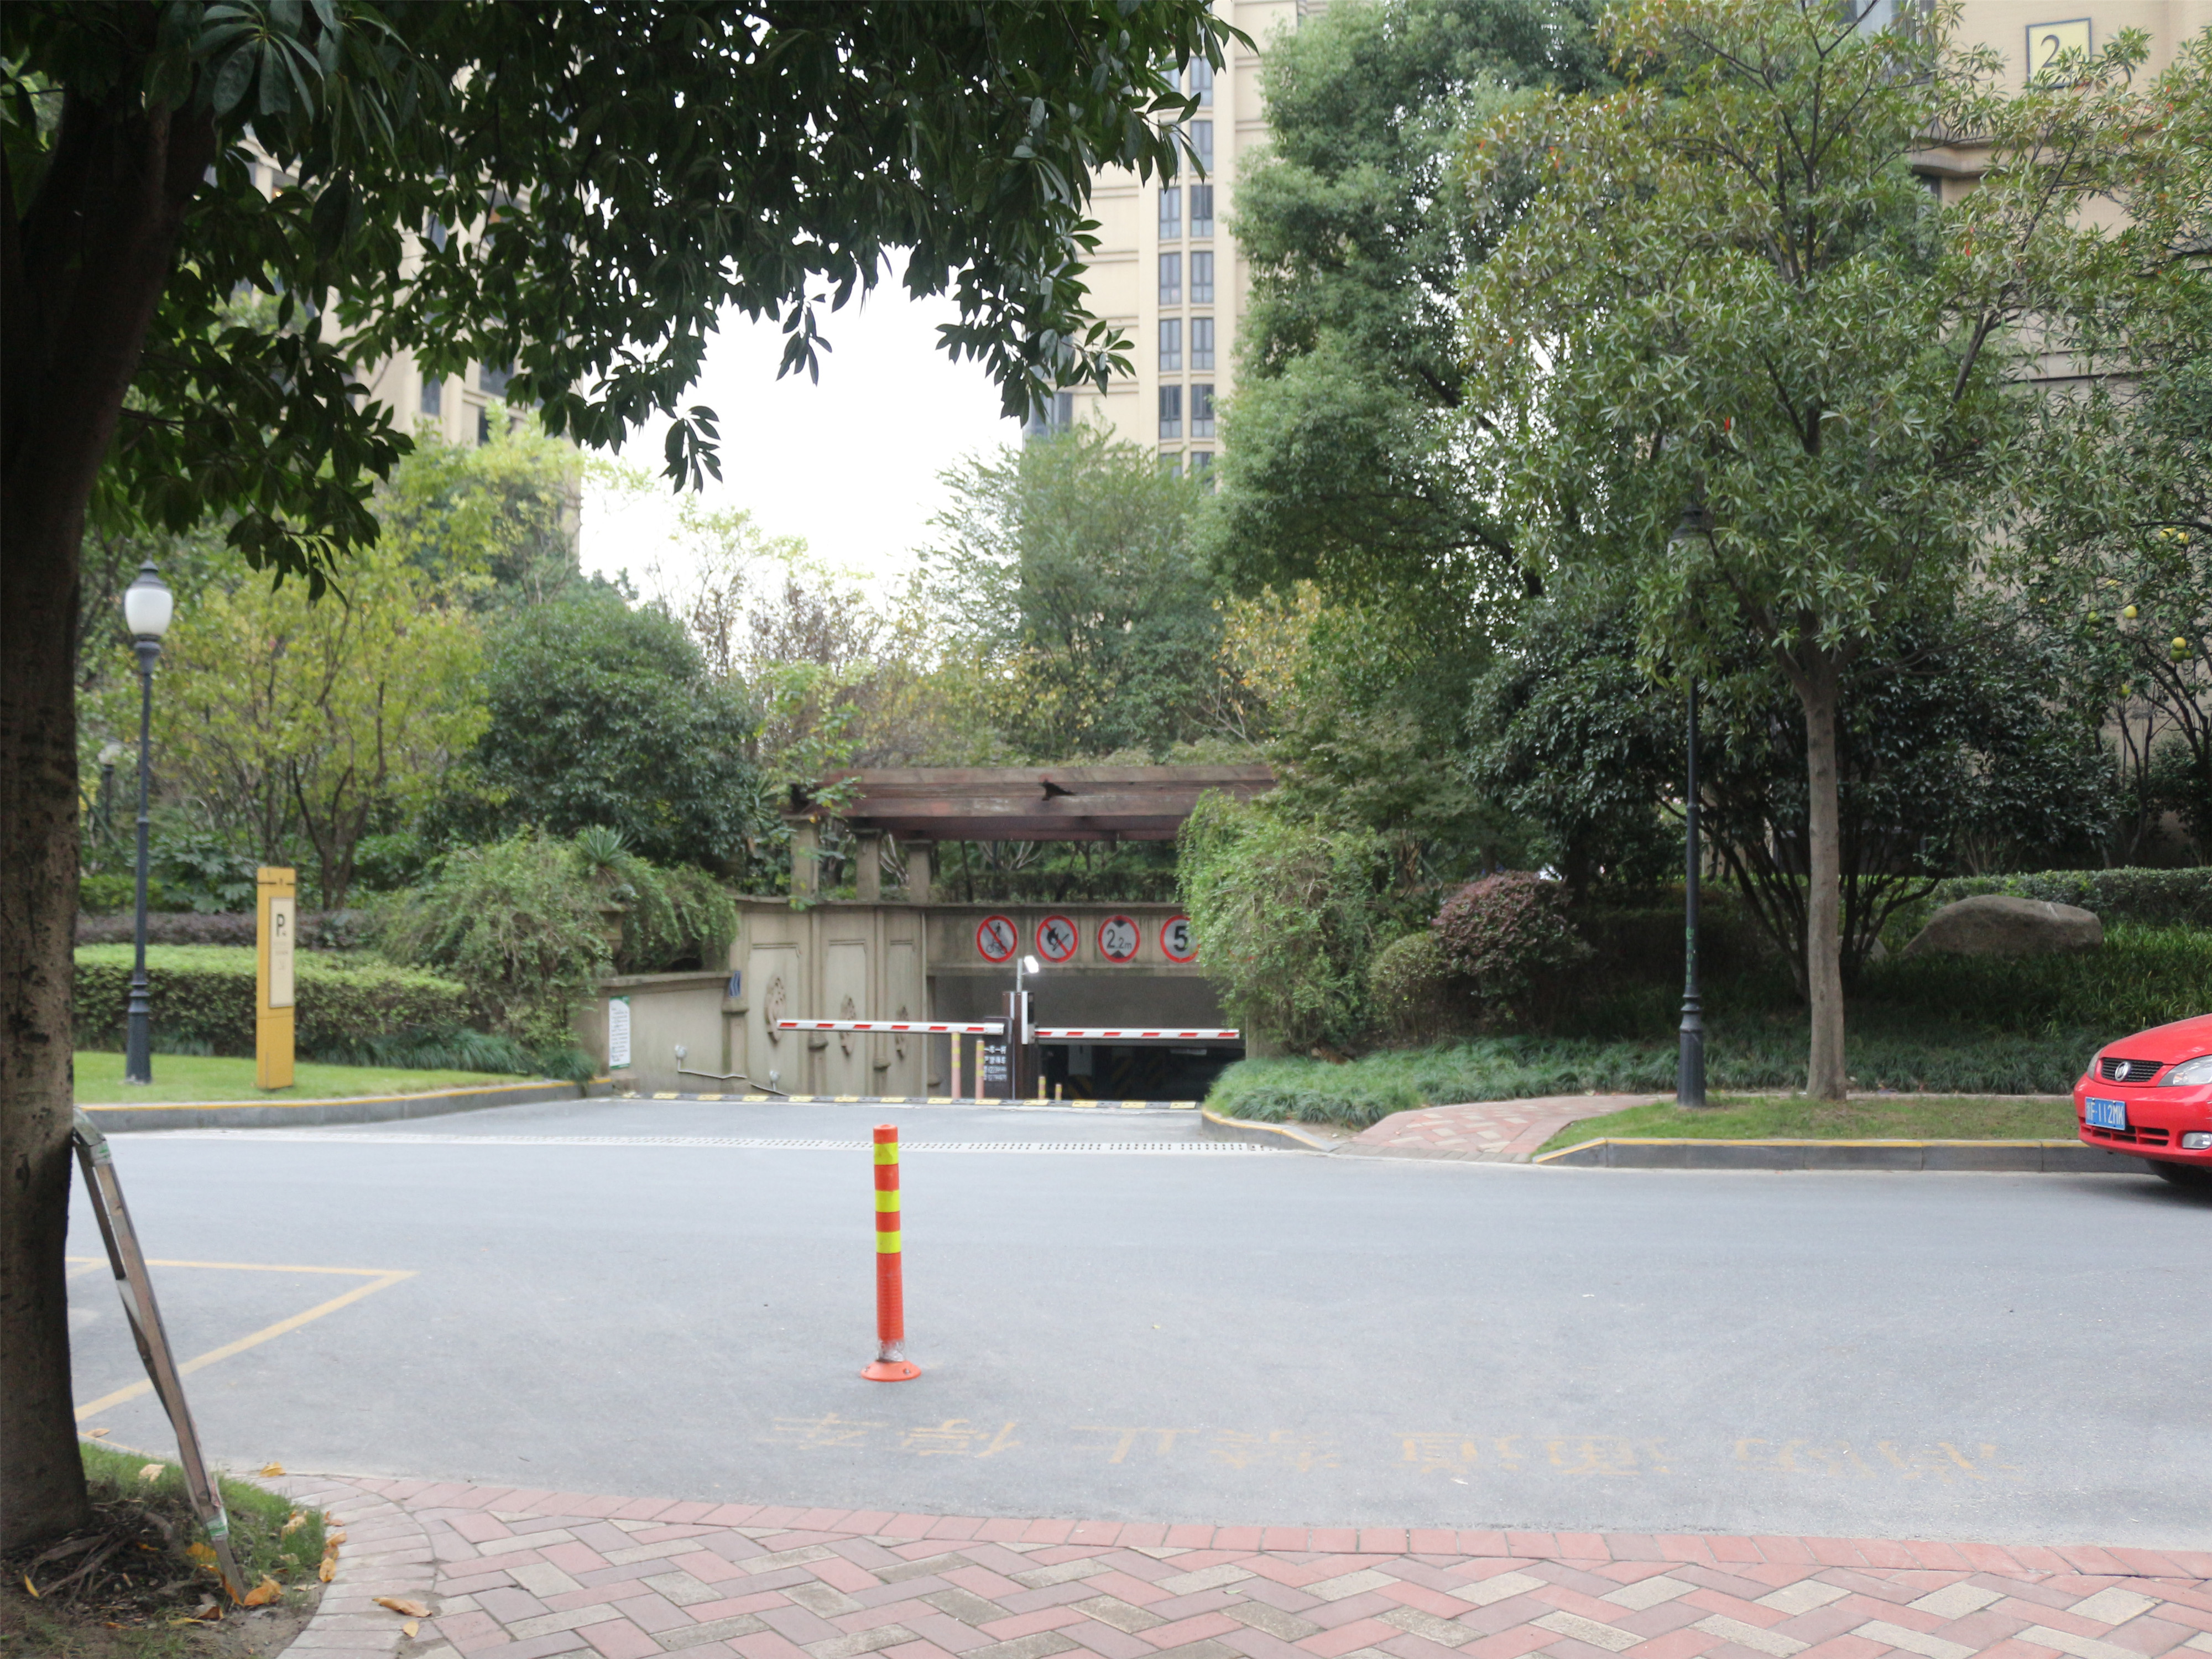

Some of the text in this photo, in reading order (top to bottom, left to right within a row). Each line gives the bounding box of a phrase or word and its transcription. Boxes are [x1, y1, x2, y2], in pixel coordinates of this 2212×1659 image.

[2041, 34, 2061, 68] 2
[276, 914, 285, 937] P
[1173, 925, 1188, 952] 5
